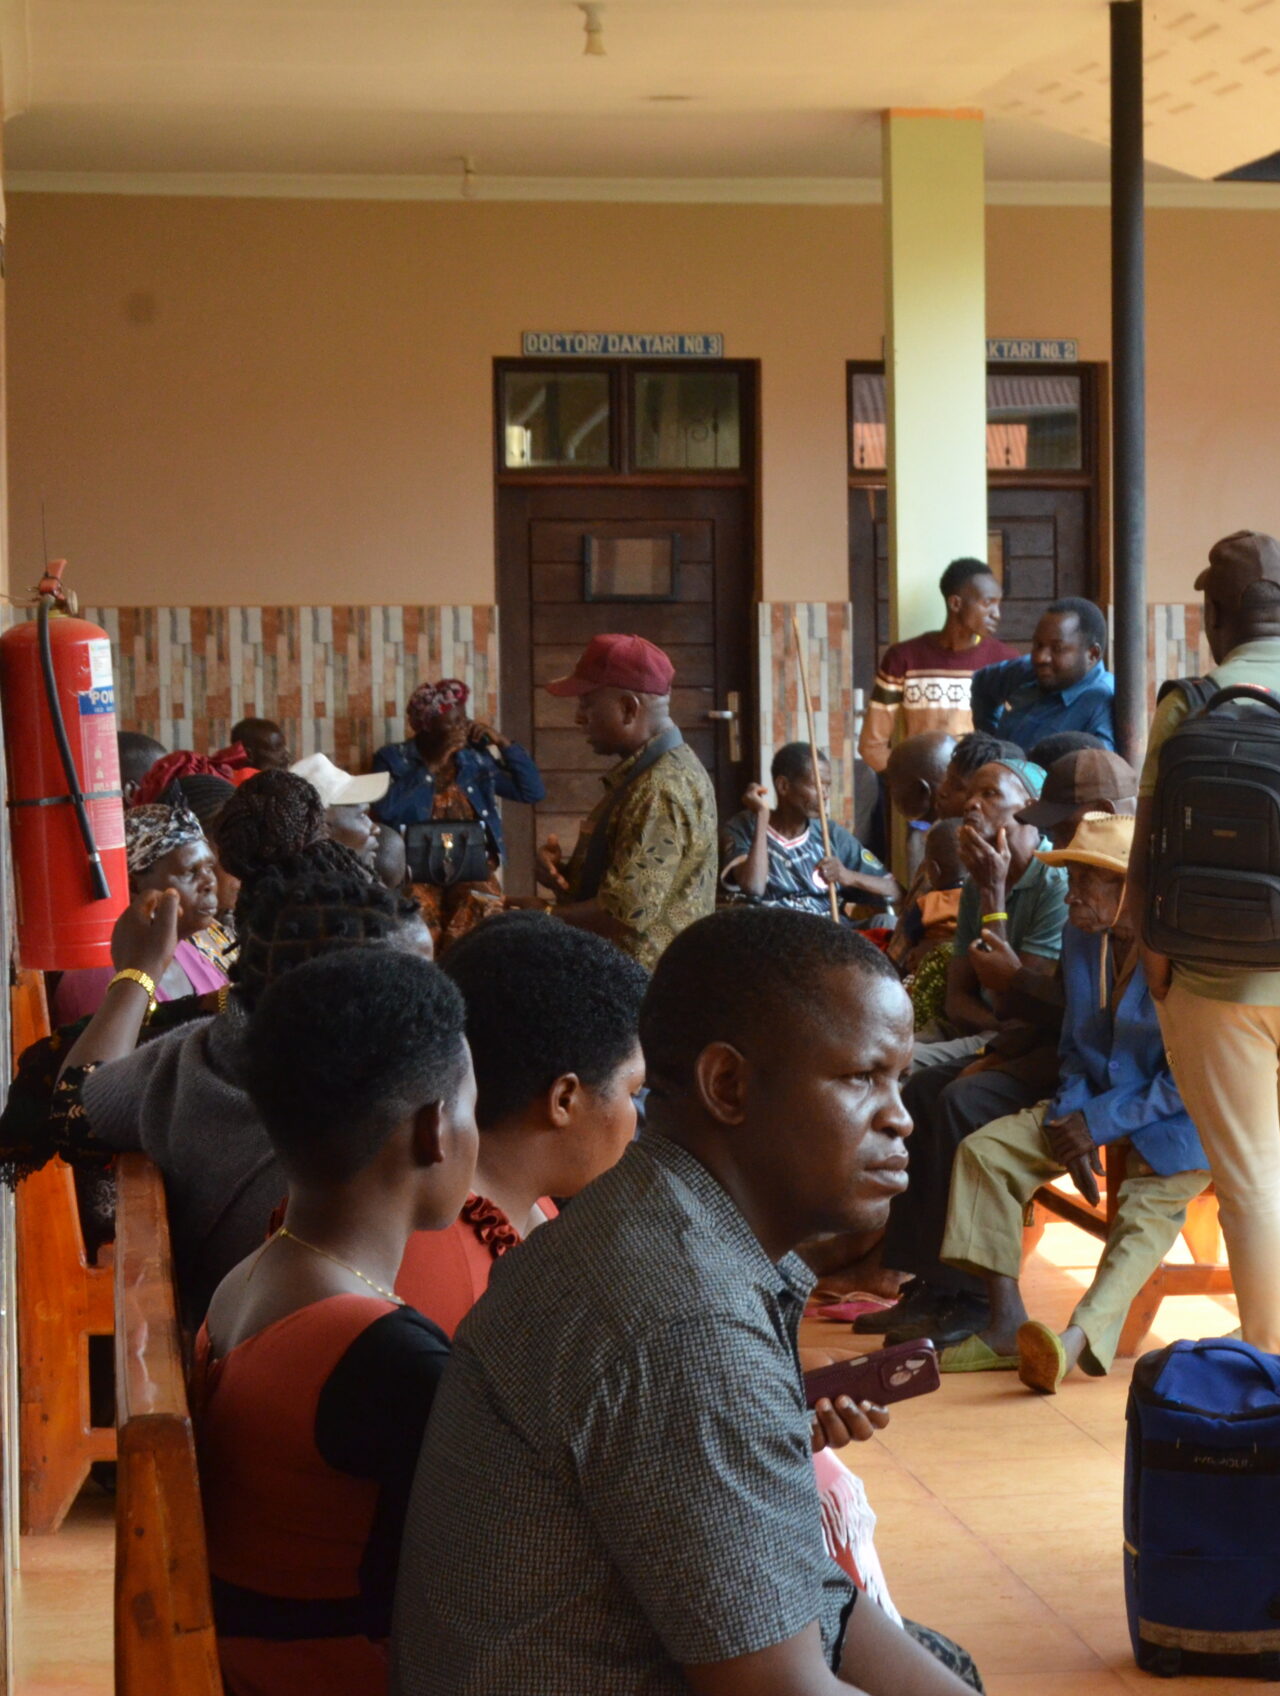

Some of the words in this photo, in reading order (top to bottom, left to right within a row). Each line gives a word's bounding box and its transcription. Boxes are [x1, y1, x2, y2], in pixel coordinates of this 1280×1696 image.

[708, 335, 718, 354] 3
[986, 341, 1036, 358] KTARI
[1064, 341, 1074, 359] 2
